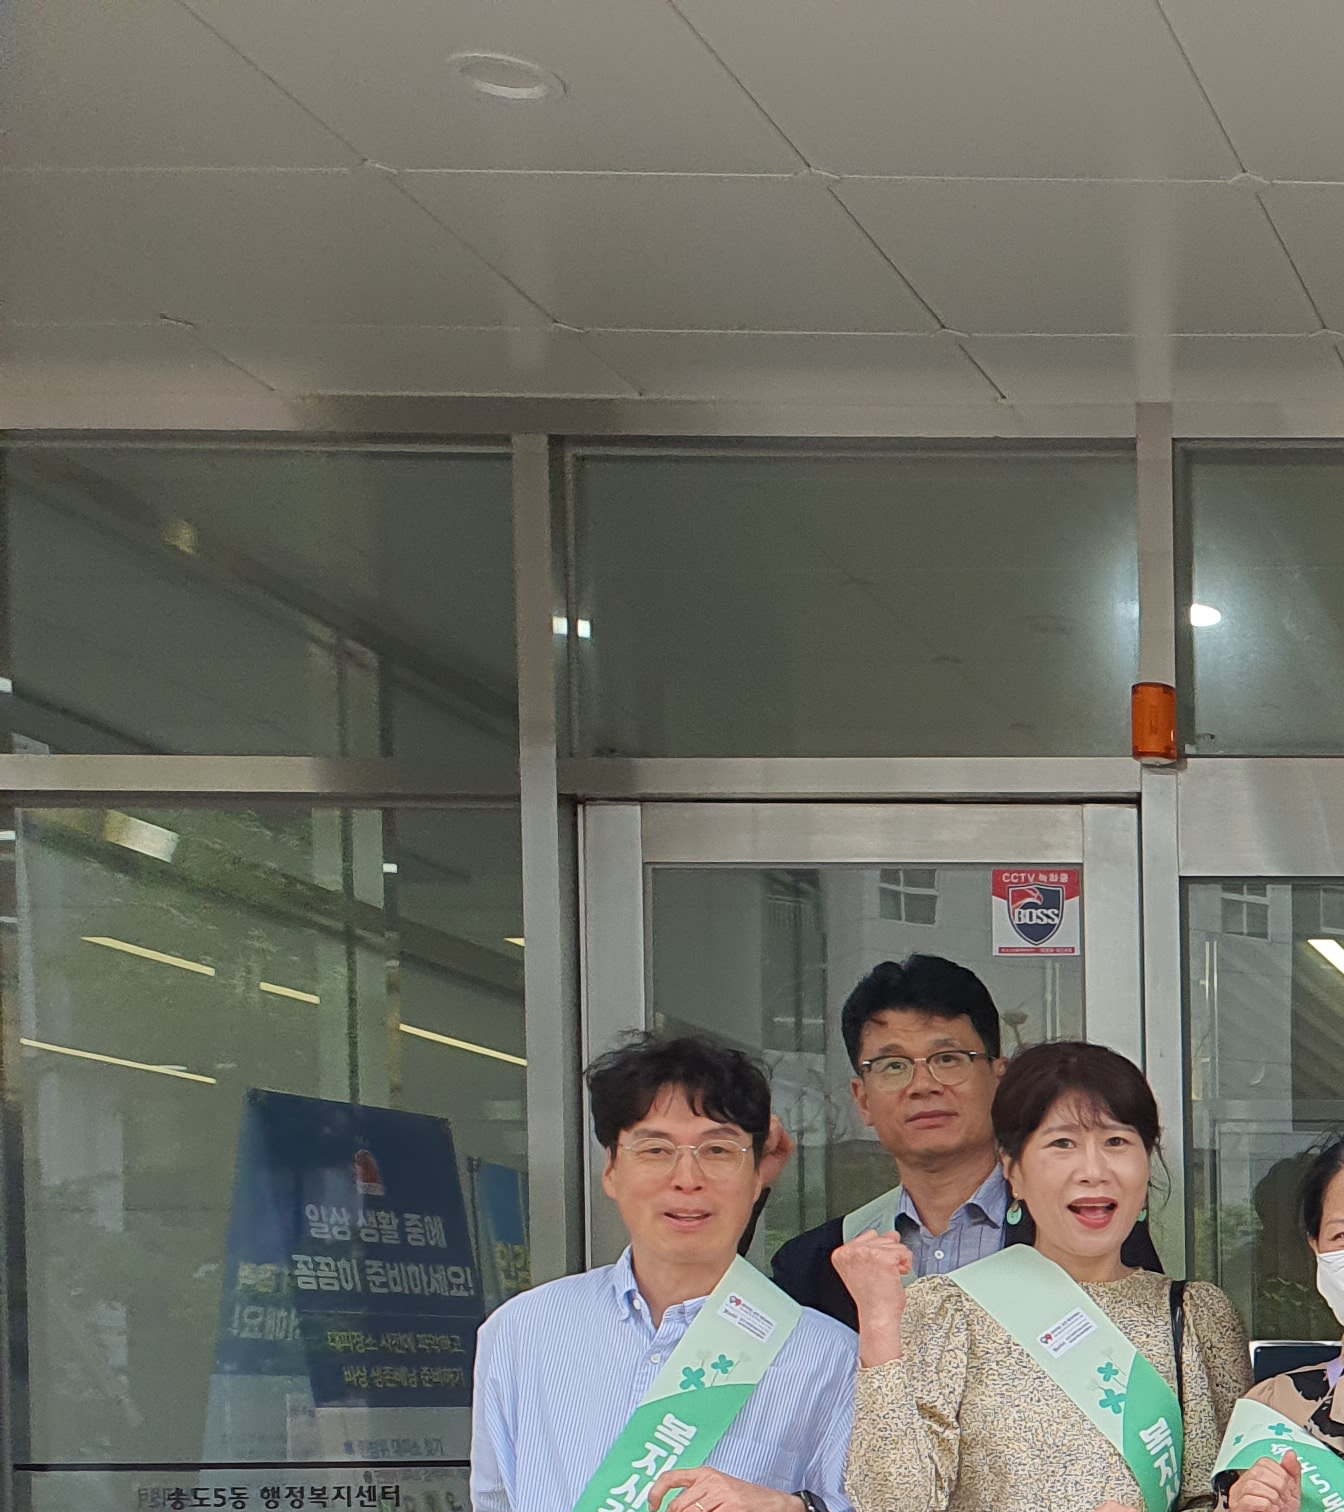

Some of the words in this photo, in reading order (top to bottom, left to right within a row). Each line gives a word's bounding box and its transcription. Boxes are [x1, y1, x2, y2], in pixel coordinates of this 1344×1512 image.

[1002, 872, 1035, 882] CCTV
[1014, 908, 1059, 925] BOSS
[305, 1203, 350, 1241] 일상
[357, 1209, 400, 1245] 생활
[403, 1213, 447, 1249] 중에
[291, 1254, 362, 1292] 꼼꼼히
[364, 1259, 475, 1297] 준비하세요!
[169, 1486, 249, 1510] 송도5동
[259, 1484, 400, 1509] 행정복지센터
